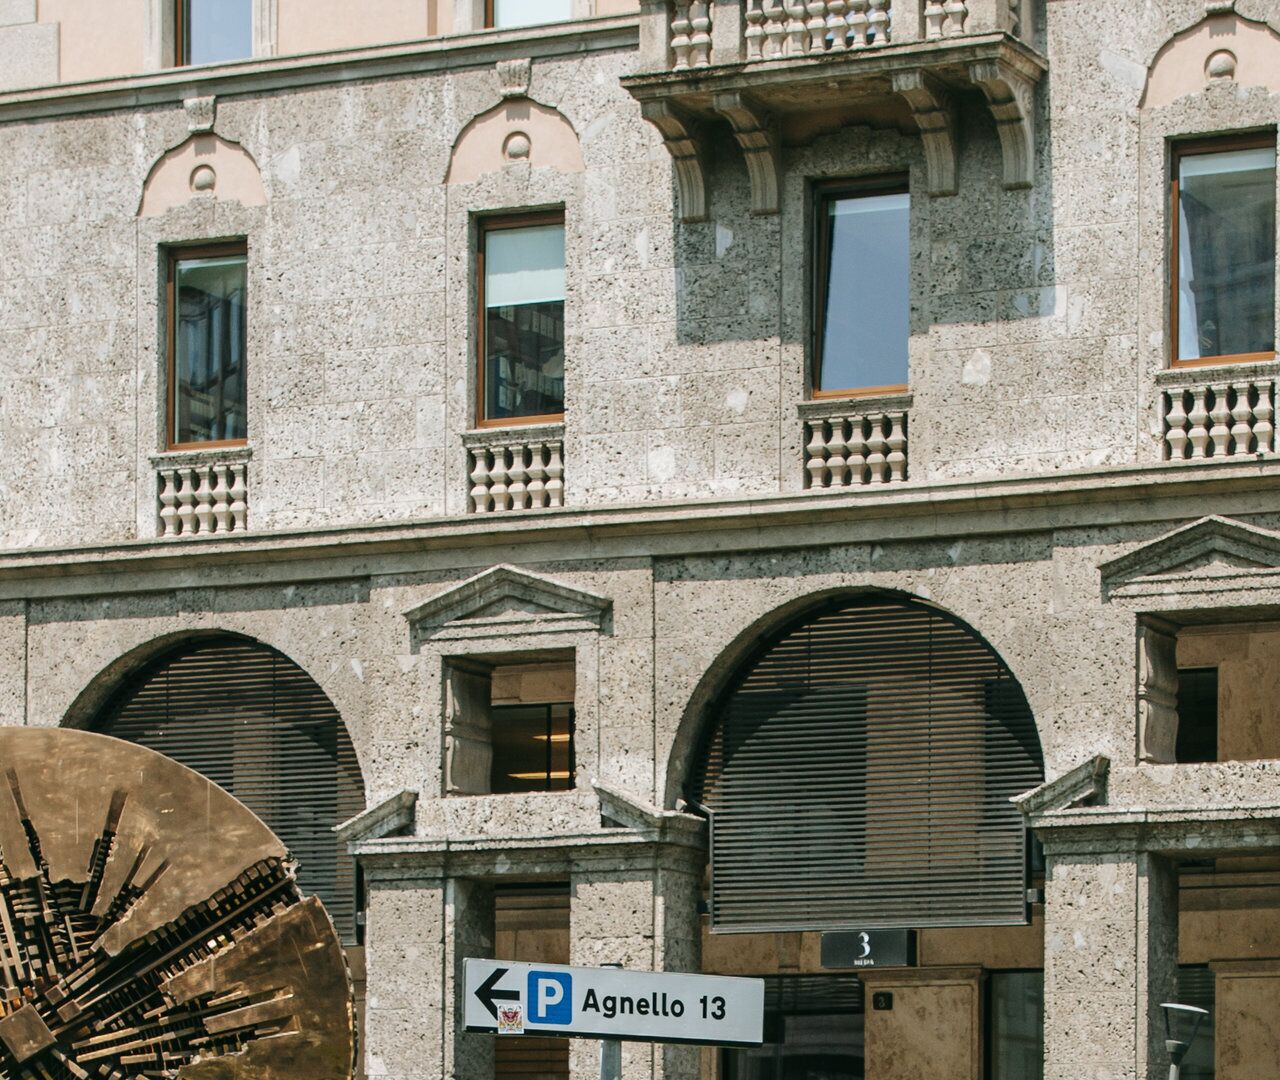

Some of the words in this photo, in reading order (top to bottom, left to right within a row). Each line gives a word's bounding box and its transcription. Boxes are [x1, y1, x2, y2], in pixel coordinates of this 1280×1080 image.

[858, 931, 871, 958] 3
[537, 978, 564, 1018] P
[582, 988, 685, 1019] Agnello
[699, 995, 726, 1020] 13
